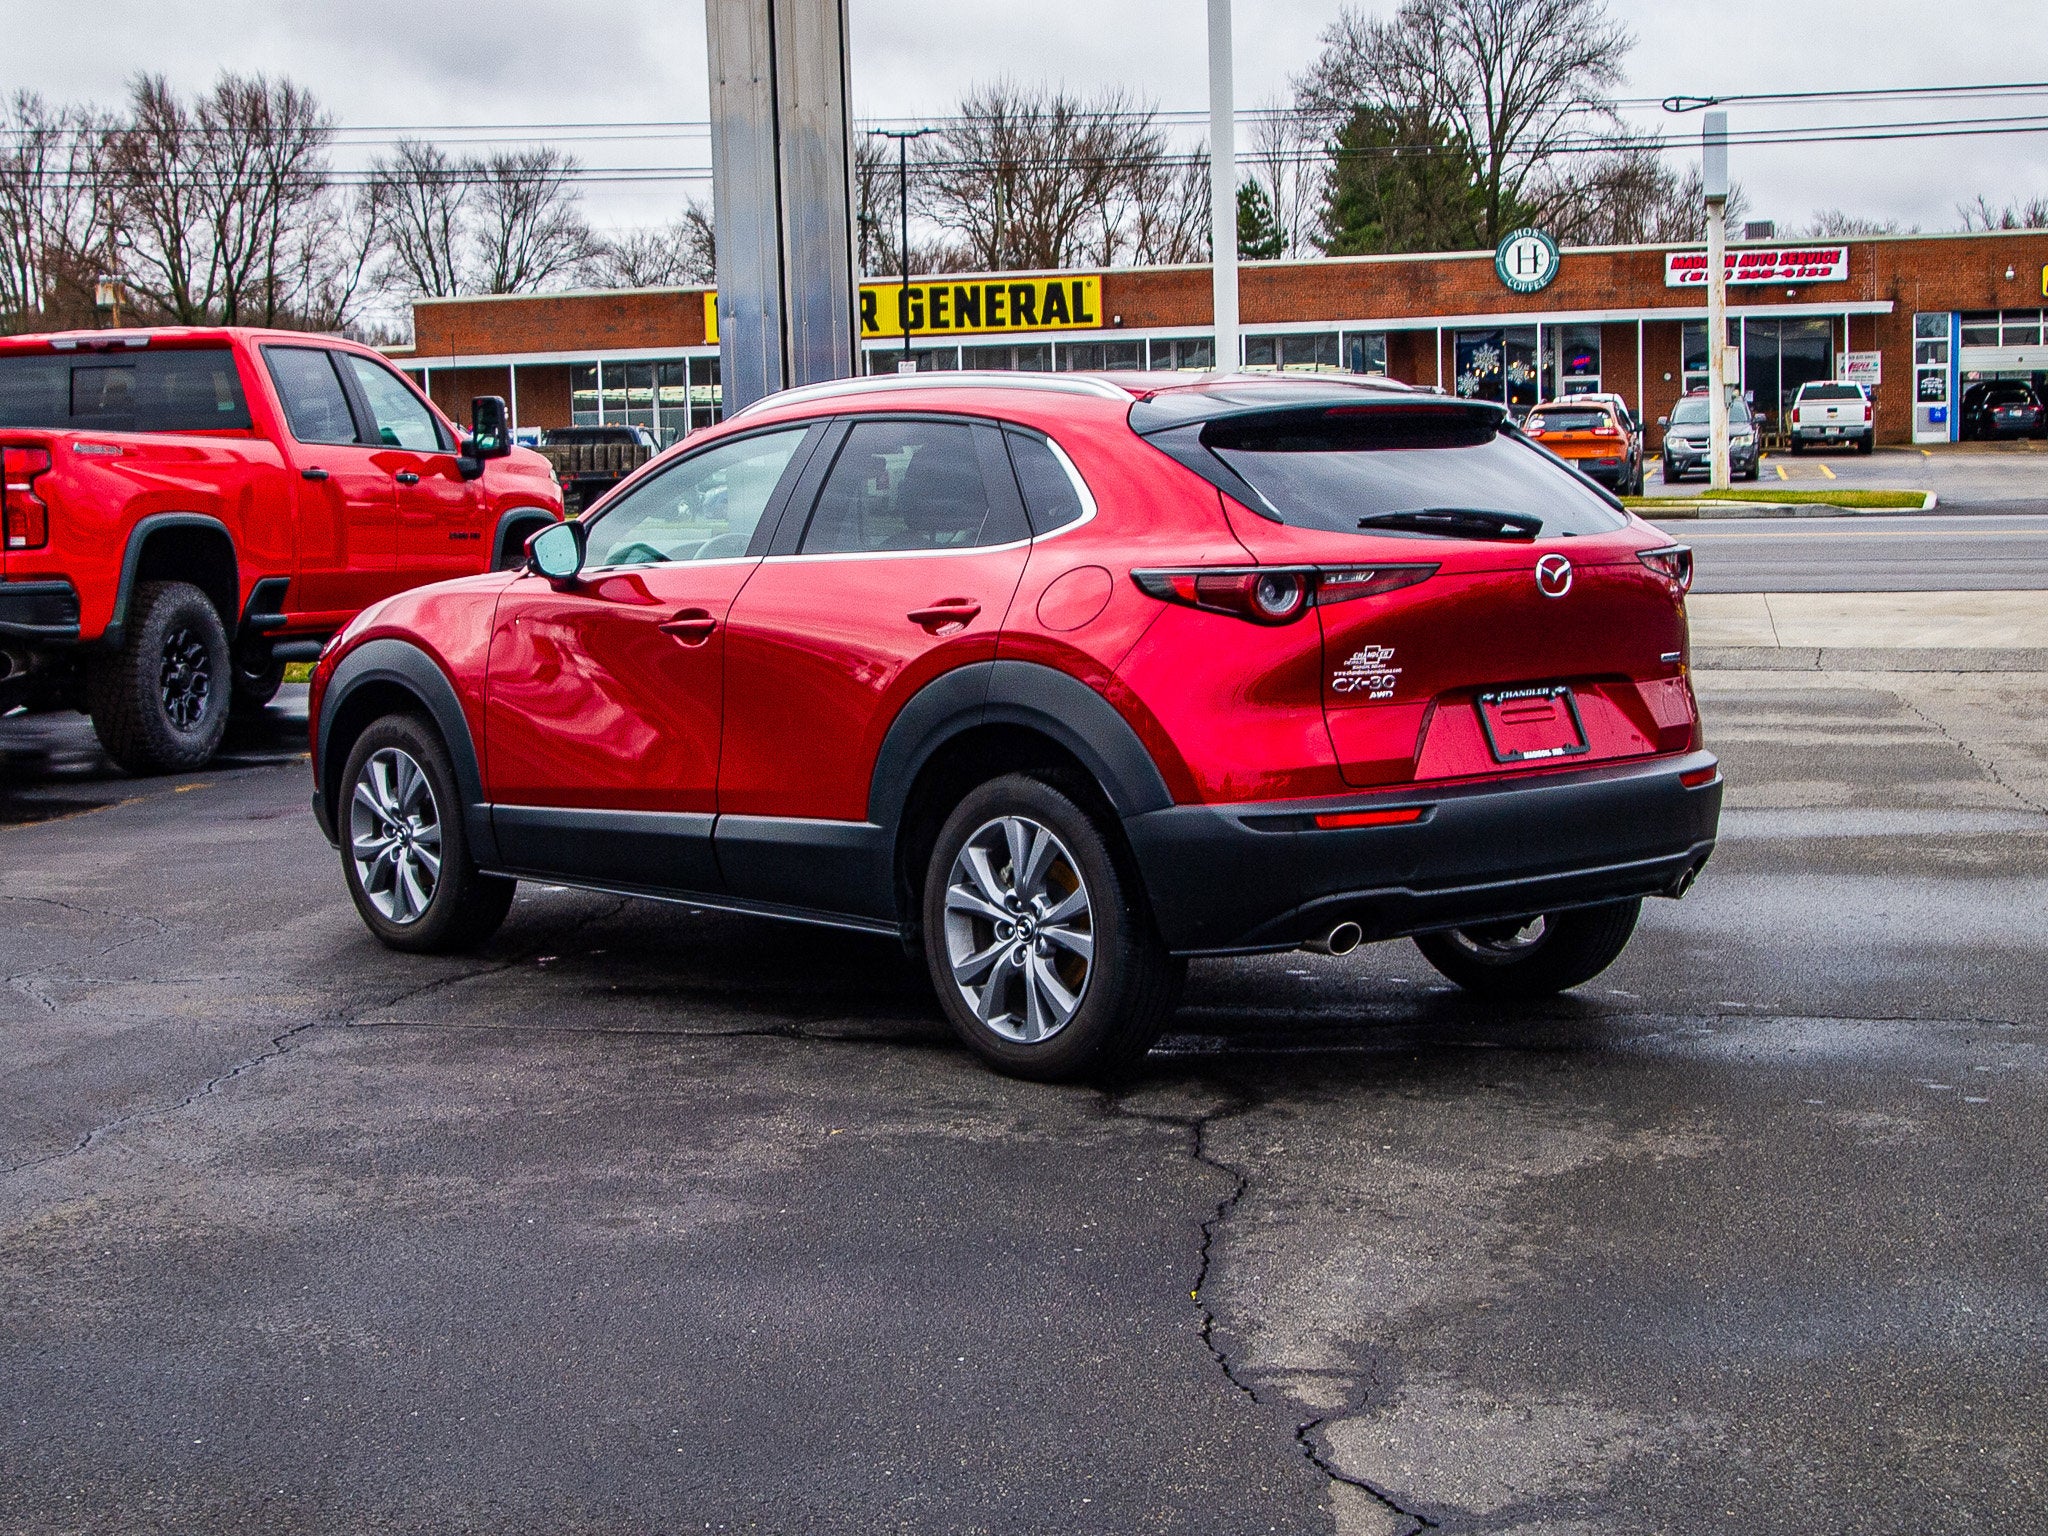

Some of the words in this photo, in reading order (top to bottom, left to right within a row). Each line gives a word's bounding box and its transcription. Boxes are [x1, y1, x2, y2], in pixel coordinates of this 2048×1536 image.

[1513, 227, 1540, 239] HOS
[1670, 254, 1738, 270] MADIN
[1738, 252, 1779, 268] AUTO
[1778, 250, 1842, 267] SERVICE
[1507, 277, 1548, 292] COFFEE
[898, 281, 1094, 331] GENERAL
[1332, 674, 1396, 692] CX-30
[1369, 690, 1394, 699] AWD
[1501, 687, 1550, 699] CHANDLER
